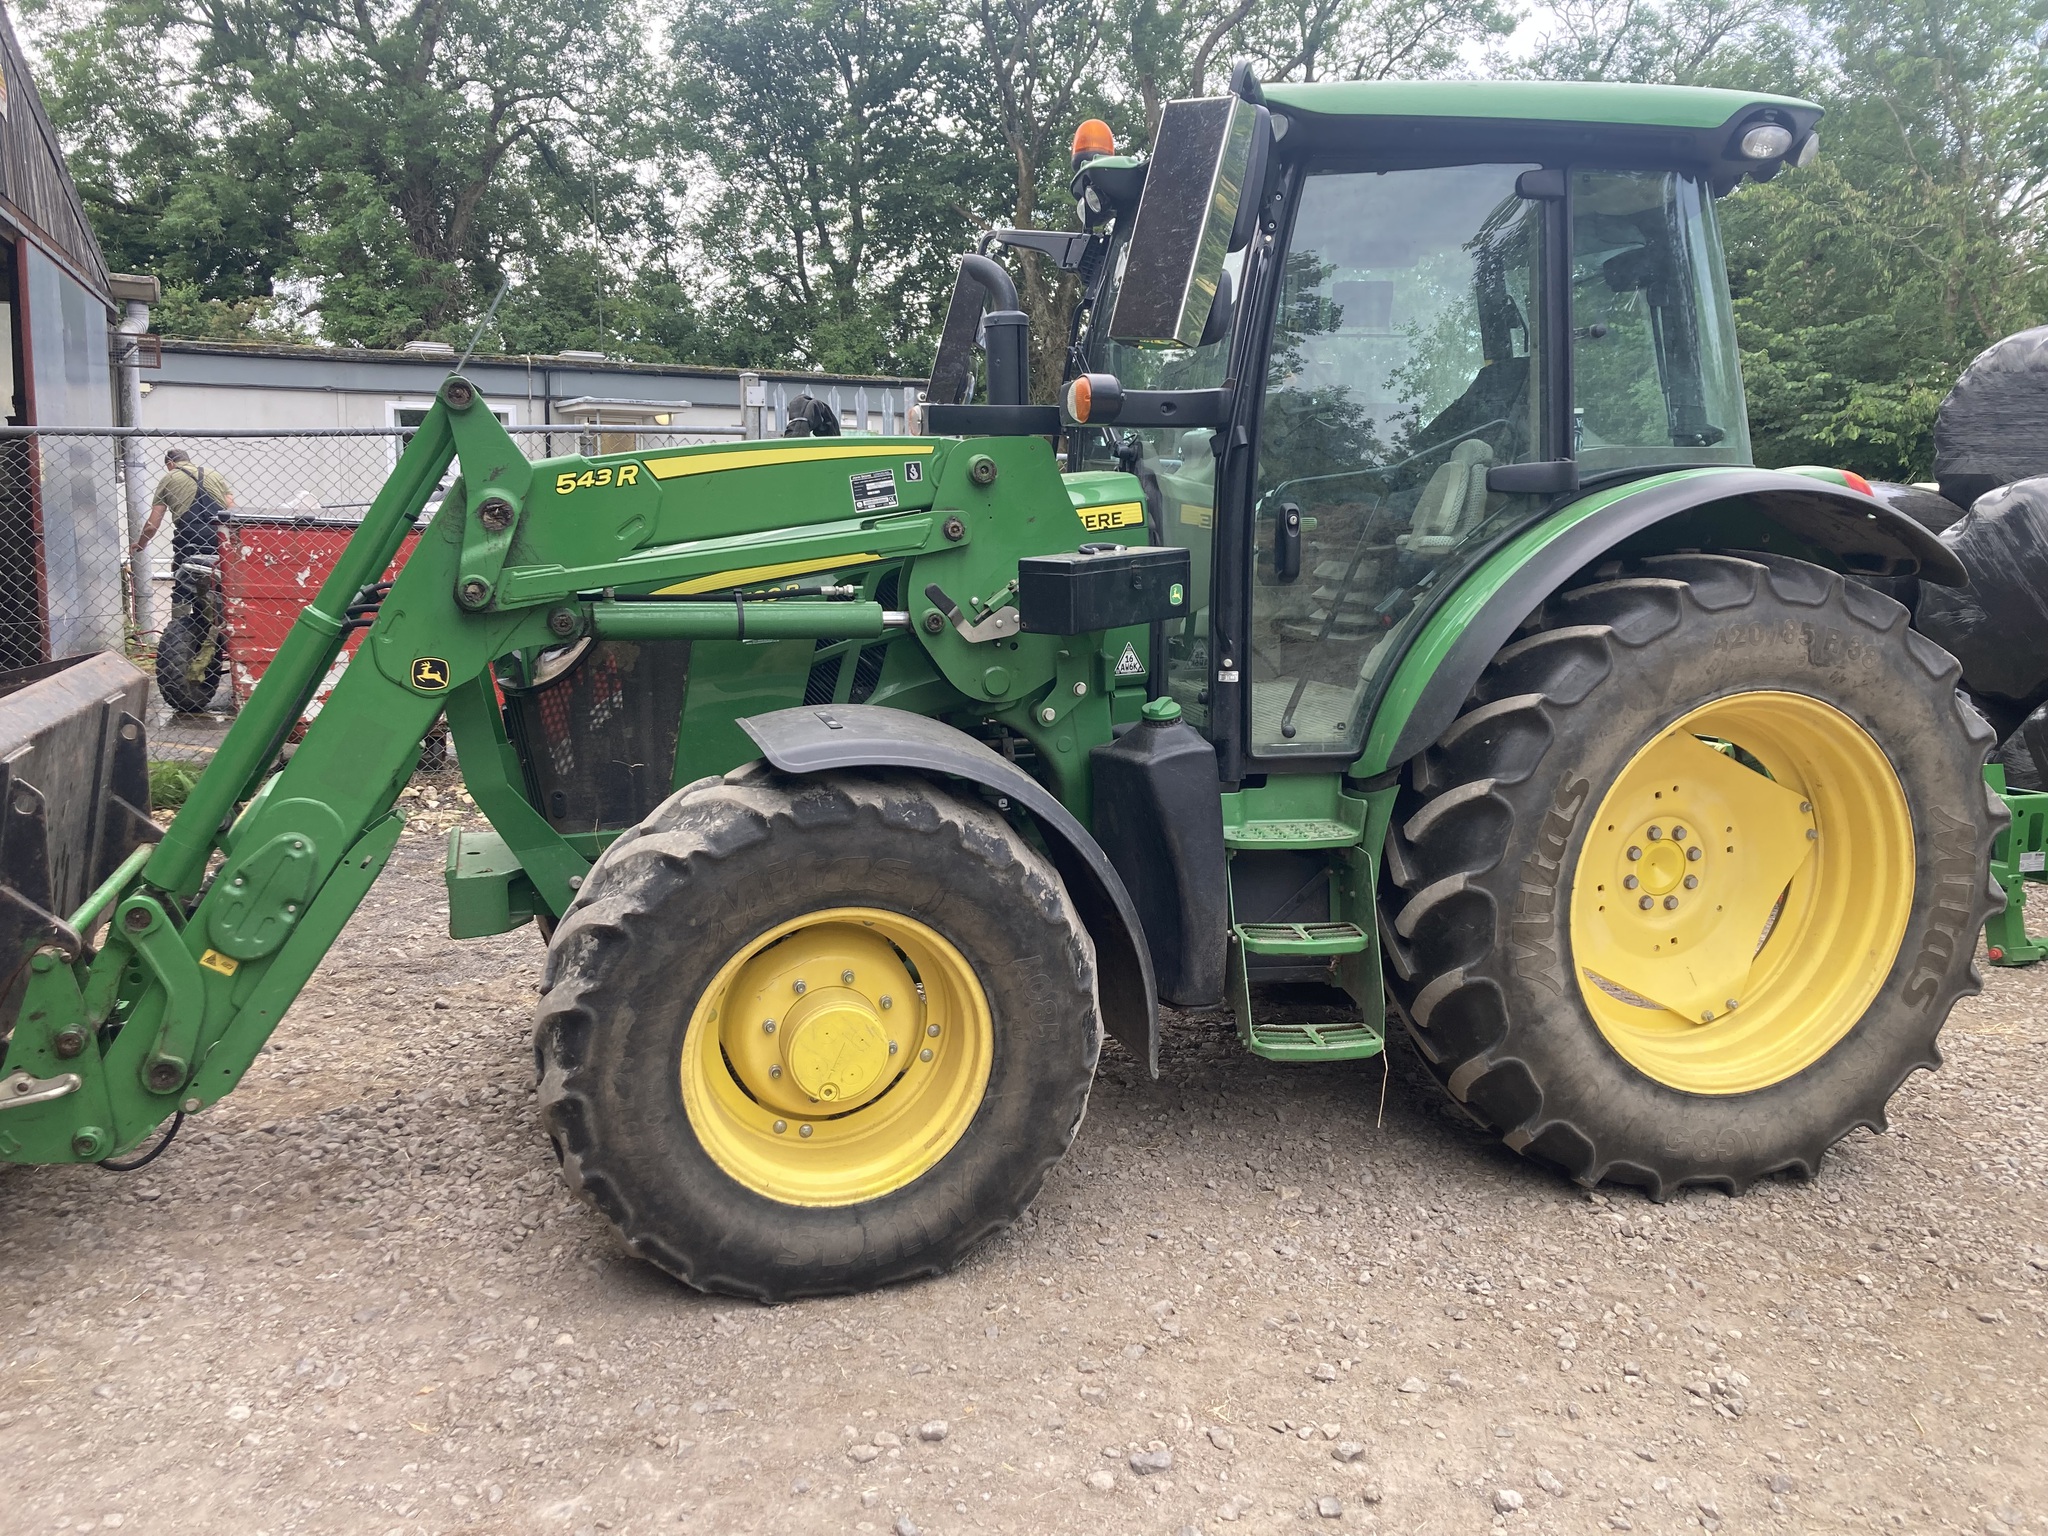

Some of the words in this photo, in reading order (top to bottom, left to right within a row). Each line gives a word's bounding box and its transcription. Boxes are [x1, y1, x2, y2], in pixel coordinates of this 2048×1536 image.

[555, 467, 613, 495] 543
[616, 463, 640, 487] R
[1080, 511, 1123, 529] ERE
[1120, 663, 1138, 671] AW6K
[1125, 655, 1134, 663] 16
[1511, 769, 1590, 996] Mitas
[1901, 805, 1976, 1014] Mitas
